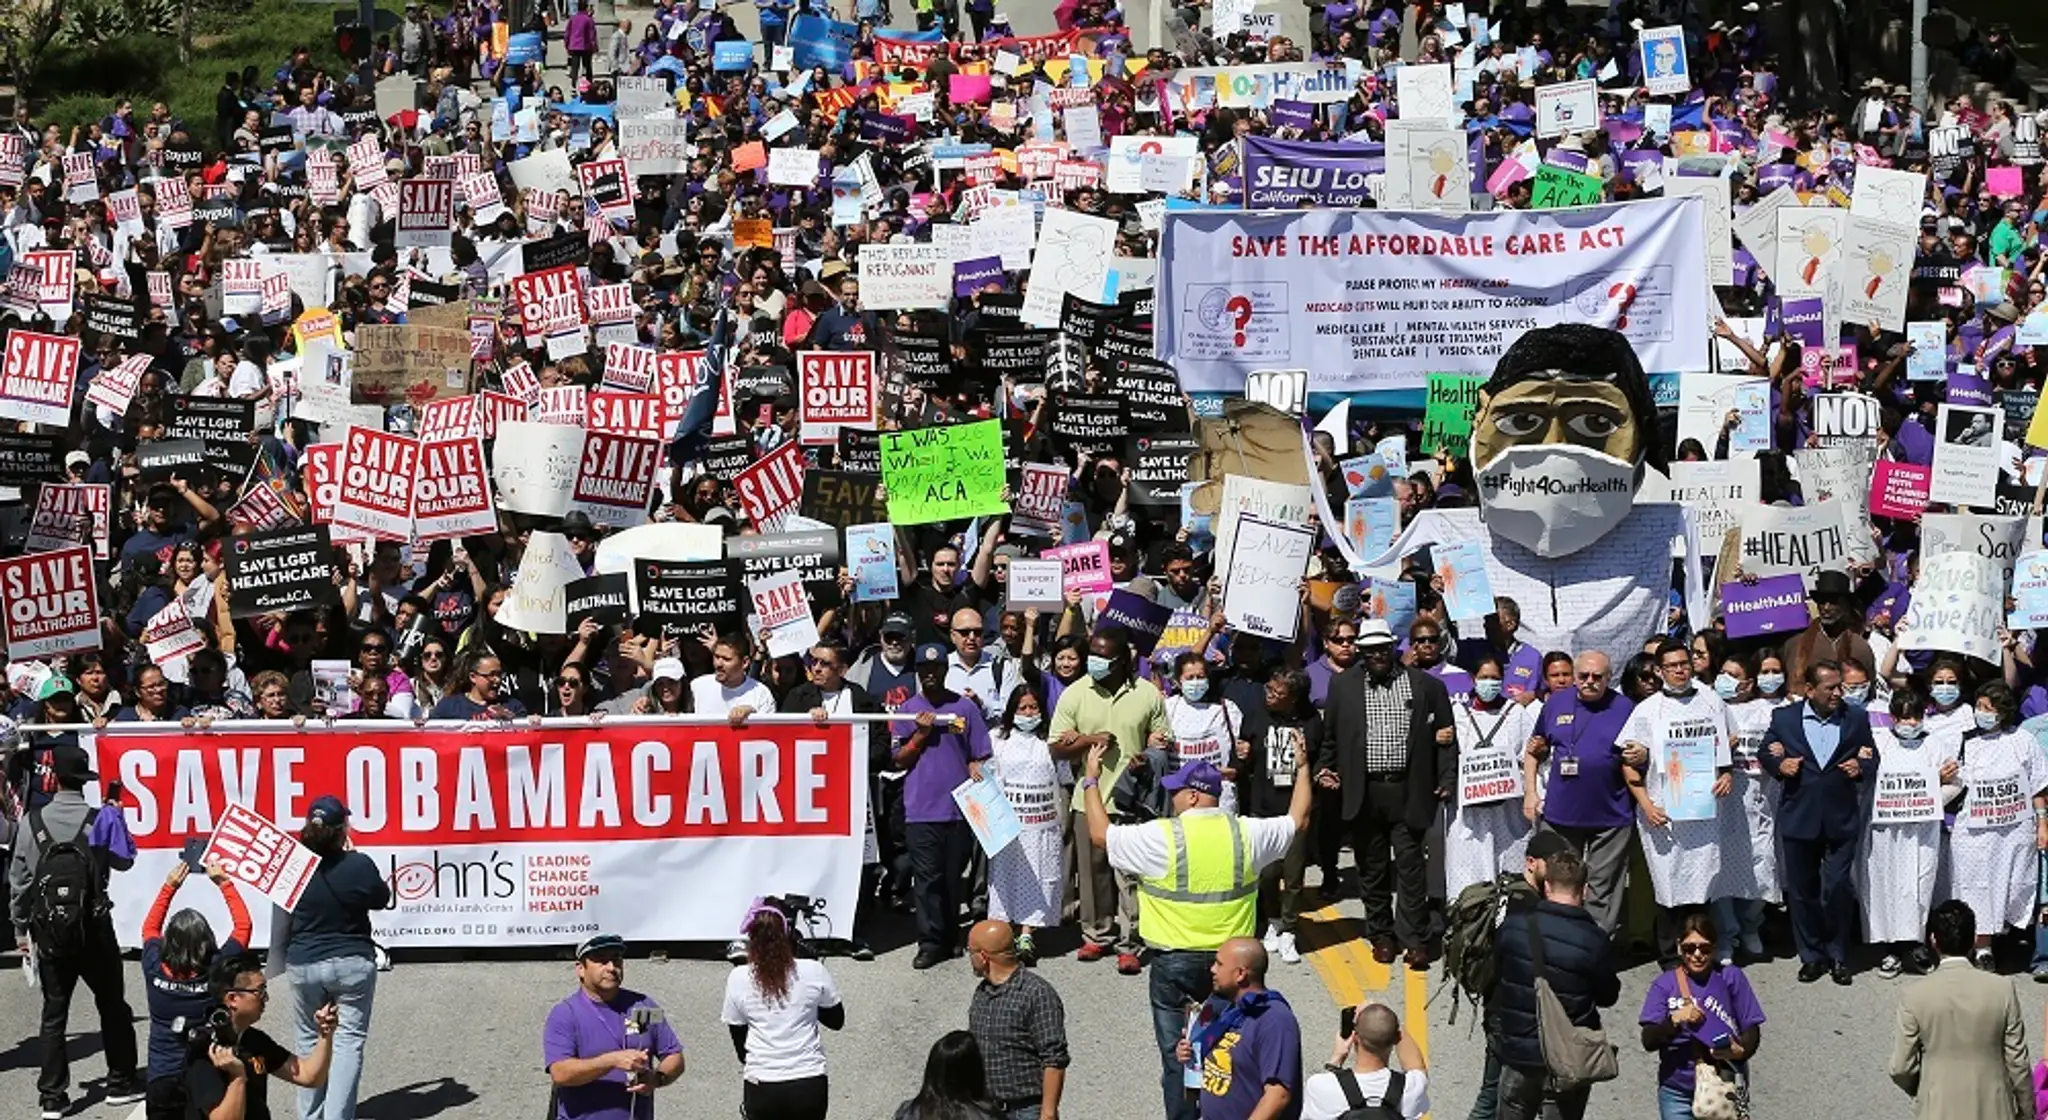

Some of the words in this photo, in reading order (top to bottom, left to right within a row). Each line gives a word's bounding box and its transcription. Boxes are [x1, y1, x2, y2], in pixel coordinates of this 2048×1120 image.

[1243, 15, 1274, 27] SAVE
[1254, 165, 1323, 189] SEIU
[403, 184, 448, 212] SAVE
[1328, 192, 1363, 208] Long
[1232, 235, 1287, 257] SAVE
[1299, 235, 1339, 257] THE
[1348, 232, 1492, 256] AFFORDABLE
[1506, 233, 1565, 256] CARE
[1579, 227, 1625, 250] ACT
[225, 262, 261, 280] SAVE
[867, 262, 937, 277] REPUGNANT
[518, 270, 574, 304] SAVE
[591, 286, 631, 309] SAVE
[544, 294, 578, 320] SAVE
[1305, 303, 1352, 313] MEDICAID
[1376, 301, 1400, 311] WILL
[1488, 298, 1503, 309] TO
[1316, 323, 1360, 335] MEDICAL
[1362, 322, 1386, 334] CARE
[1407, 321, 1449, 331] MENTAL
[1488, 318, 1538, 330] SERVICES
[1351, 334, 1407, 347] SUBSTANCE
[1409, 333, 1446, 345] ABUSE
[8, 337, 73, 382] SAVE
[608, 344, 651, 375] SAVE
[1353, 348, 1388, 360] DENTAL
[1391, 347, 1416, 358] CARE
[1439, 346, 1475, 357] VISION
[807, 359, 867, 386] SAVE
[807, 387, 868, 406] OUR
[1117, 377, 1146, 390] SAVE
[1148, 381, 1177, 393] LGBT
[1249, 373, 1306, 414] NO!
[1431, 380, 1480, 404] Health
[541, 387, 583, 413] SAVE
[175, 416, 206, 427] SAVE
[209, 418, 241, 429] LGBT
[424, 401, 472, 431] SAVE
[592, 398, 660, 429] SAVE
[807, 407, 868, 418] HEALTHCARE
[1058, 412, 1085, 425] SAVE
[1088, 414, 1119, 426] LGBT
[1464, 408, 1475, 421] is
[1819, 397, 1876, 436] NO!
[166, 427, 250, 442] HEALTHCARE
[887, 434, 903, 452] I
[912, 429, 949, 448] WAS
[1053, 422, 1128, 437] HEALTHCARE
[350, 433, 415, 477] SAVE
[584, 437, 654, 482] SAVE
[1139, 456, 1171, 468] SAVE
[347, 465, 409, 500] OUR
[417, 474, 482, 500] OUR
[580, 476, 647, 501] OBAMACARE
[739, 450, 805, 520] SAVE
[925, 481, 968, 503] ACA
[1024, 470, 1067, 495] SAVE
[1483, 474, 1628, 497] #Fight4OurHealth
[1671, 486, 1742, 501] HEALTH
[344, 486, 407, 512] HEALTHCARE
[418, 495, 485, 513] HEALTHCARE
[1019, 491, 1063, 512] OUR
[1240, 530, 1304, 557] SAVE
[1743, 526, 1844, 566] #HEALTH
[240, 557, 277, 573] SAVE
[279, 551, 317, 568] LGBT
[745, 557, 781, 571] SAVE
[785, 554, 822, 568] LGBT
[1064, 553, 1102, 575] CARE
[6, 555, 86, 599] SAVE
[232, 565, 330, 590] HEALTHCARE
[1017, 574, 1055, 583] SUPPORT
[650, 586, 684, 599] SAVE
[687, 585, 726, 599] LGBT
[755, 582, 805, 615] SAVE
[1027, 588, 1045, 597] ACA
[12, 590, 90, 622] OUR
[643, 599, 737, 614] HEALTHCARE
[13, 612, 92, 637] HEALTHCARE
[119, 748, 306, 836] SAVE
[346, 740, 829, 832] OBAMACARE
[1464, 779, 1517, 800] CANCER?
[214, 808, 263, 876] SAVE
[237, 828, 281, 884] OUR
[258, 838, 295, 893] HEALTHCARE
[529, 855, 591, 867] LEADING
[529, 870, 589, 882] CHANGE
[529, 884, 600, 897] THROUGH
[529, 900, 584, 913] HEALTH
